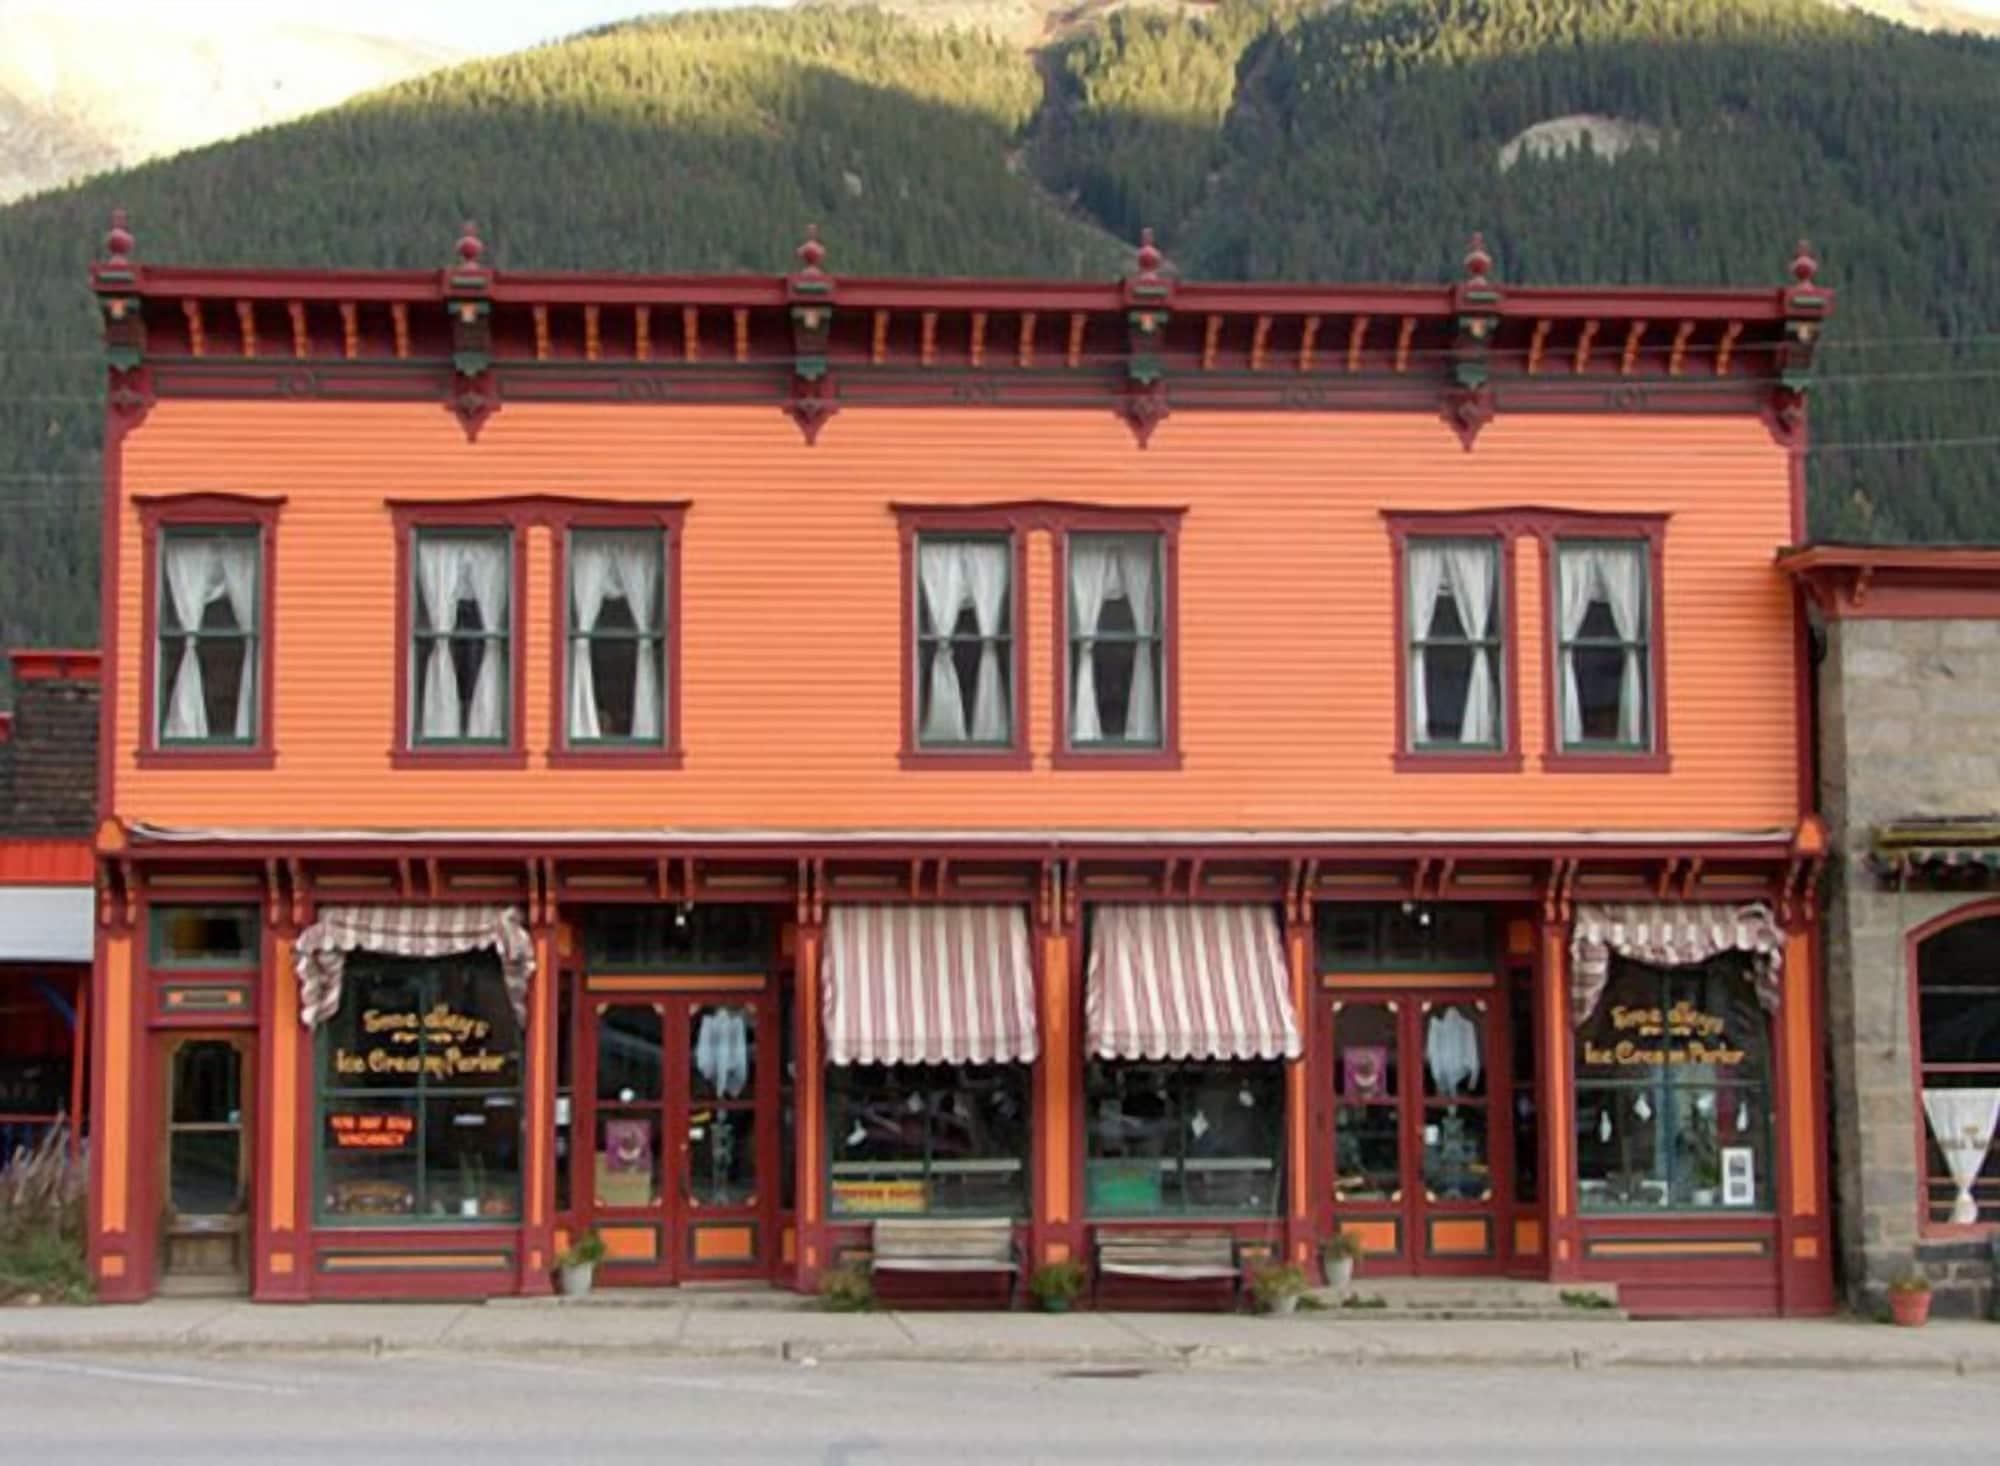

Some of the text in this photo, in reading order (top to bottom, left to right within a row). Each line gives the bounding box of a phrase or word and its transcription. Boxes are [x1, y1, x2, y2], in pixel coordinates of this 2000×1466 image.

[337, 1048, 365, 1073] Ice
[368, 1047, 445, 1075] Cream
[1585, 1040, 1745, 1064] Ice Cream Parlor
